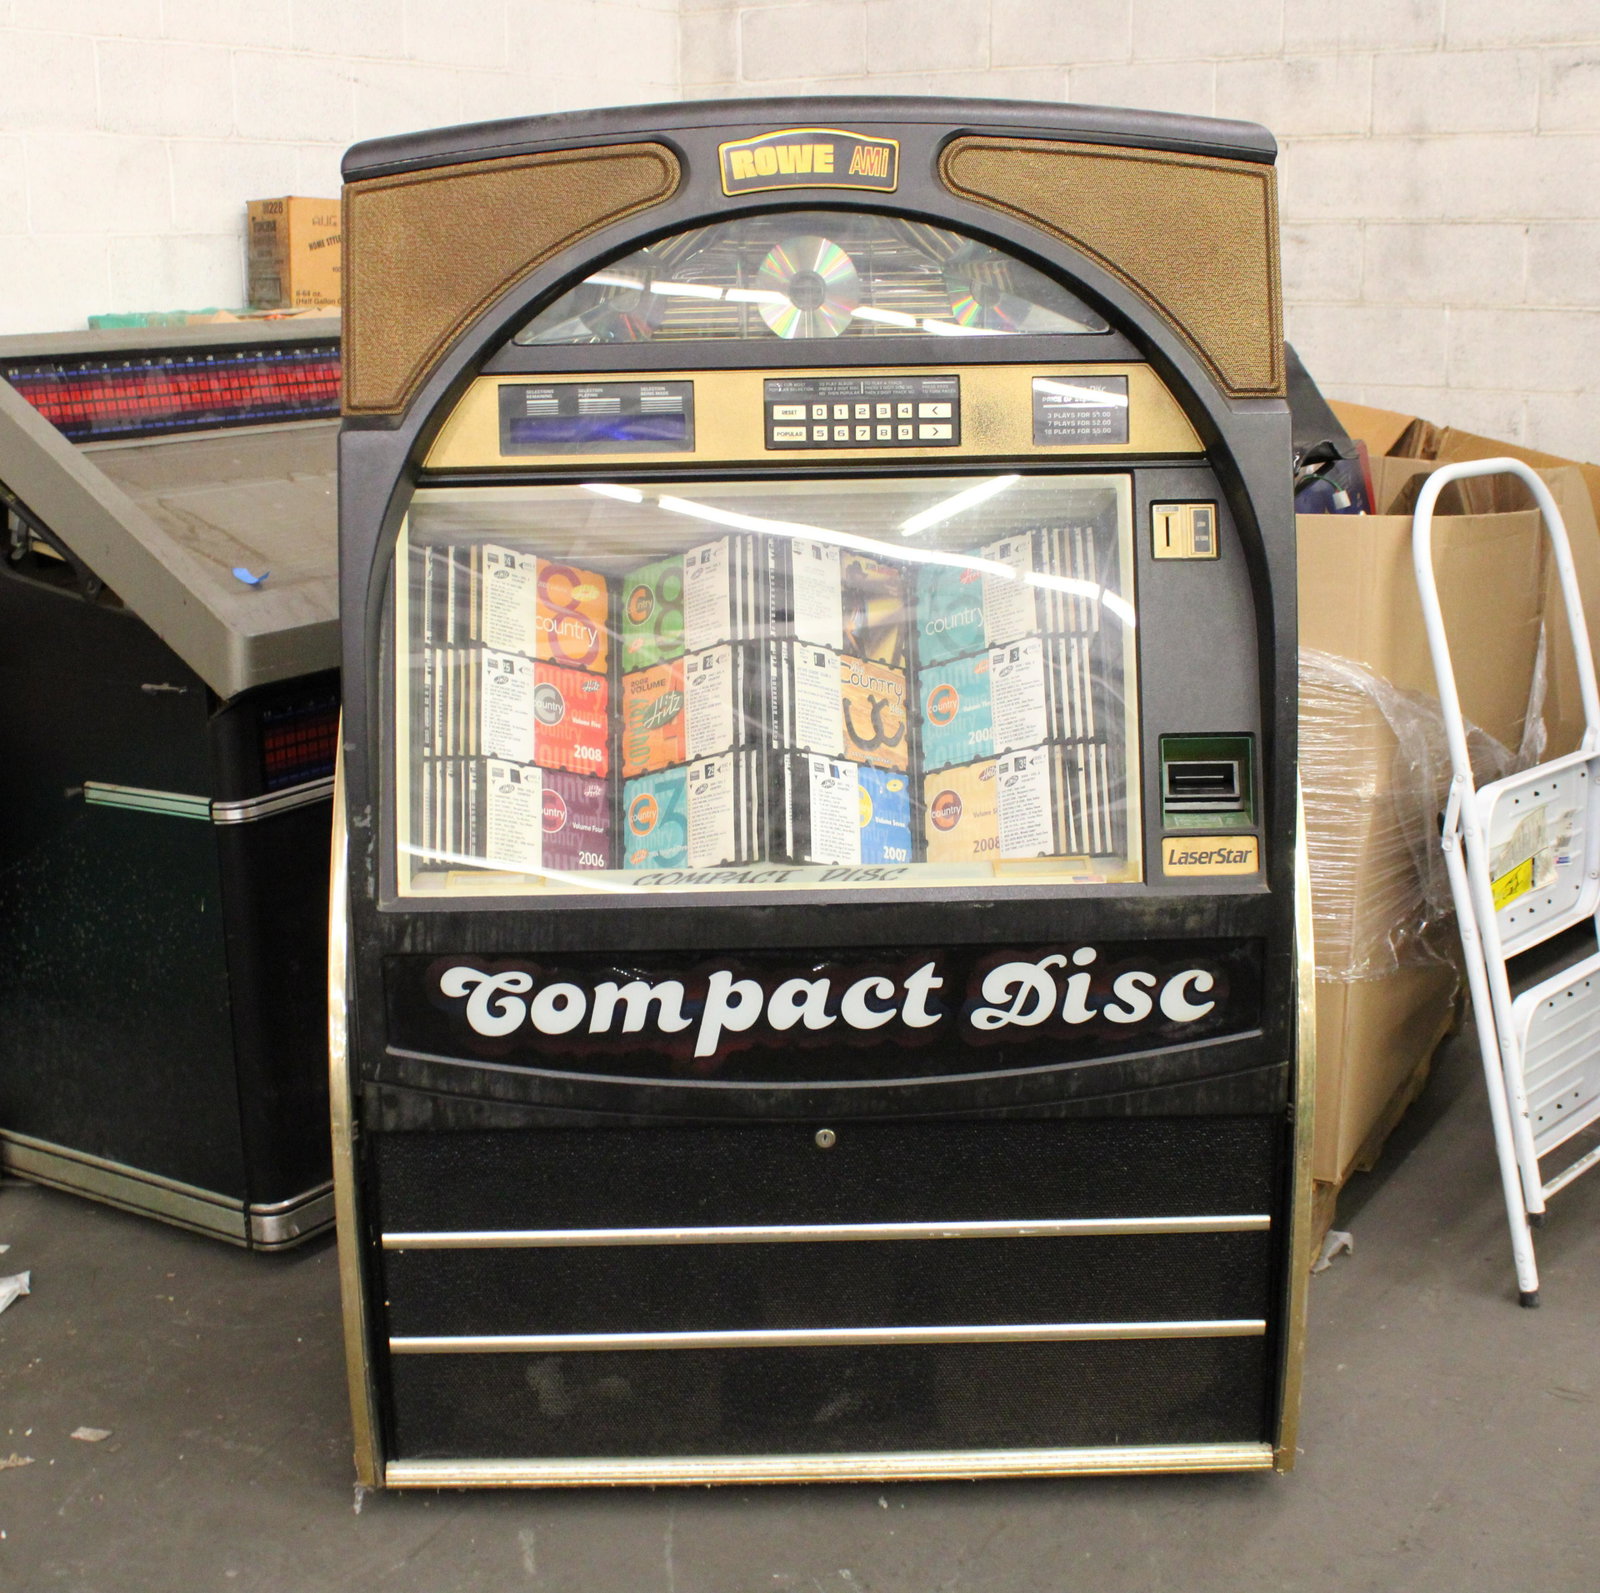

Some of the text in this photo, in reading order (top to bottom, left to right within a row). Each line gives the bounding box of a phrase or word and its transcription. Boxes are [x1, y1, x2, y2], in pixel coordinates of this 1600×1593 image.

[730, 144, 834, 180] ROWE
[816, 408, 823, 416] 0
[838, 408, 843, 416] 1
[879, 407, 888, 415] 3
[901, 428, 909, 436] 9
[630, 678, 666, 695] VOLUME
[536, 700, 563, 716] ountry
[573, 744, 603, 762] 2008
[931, 804, 962, 818] country
[572, 822, 604, 833] Volume Four
[578, 851, 605, 867] 2006
[883, 846, 907, 861] 2007
[1168, 848, 1252, 865] LaserStar
[633, 868, 907, 886] COMPACT DISC
[440, 947, 1216, 1057] Compact Disc
